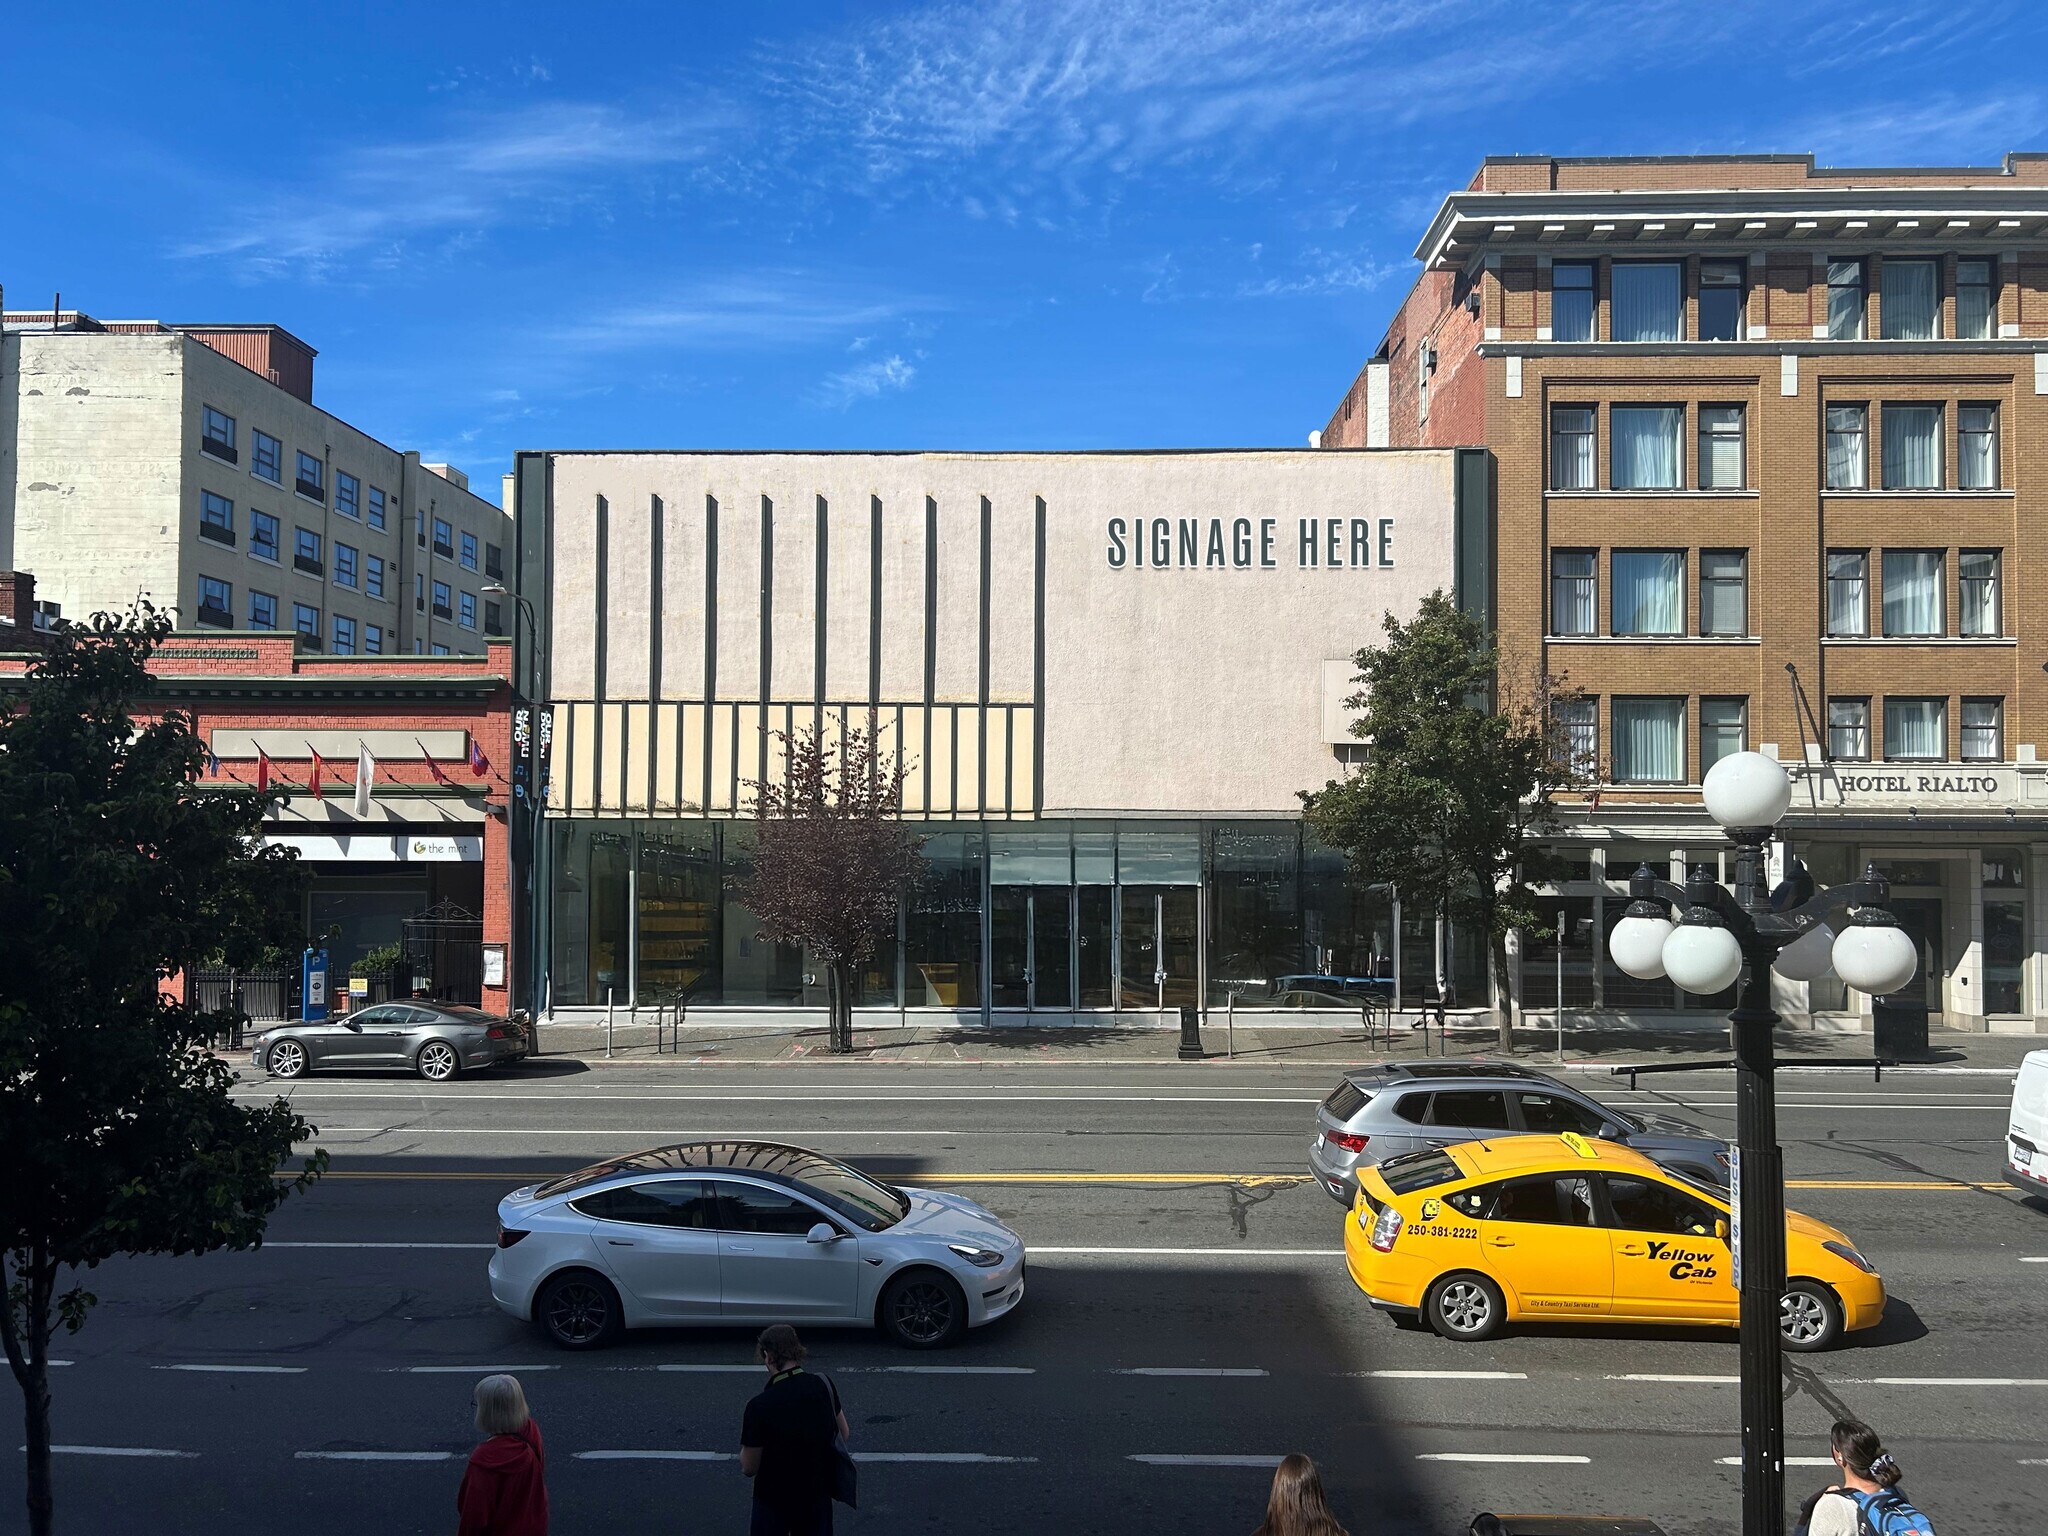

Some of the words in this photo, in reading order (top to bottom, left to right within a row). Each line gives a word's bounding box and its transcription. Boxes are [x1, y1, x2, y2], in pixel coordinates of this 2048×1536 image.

[1107, 517, 1277, 568] SIGNAGE
[1299, 517, 1395, 568] HERE
[514, 709, 524, 742] OUR
[1840, 776, 1911, 792] HOTEL
[1917, 776, 1998, 793] RIALTO
[428, 843, 444, 854] the
[448, 844, 468, 854] mint
[1731, 1151, 1740, 1197] BUS
[1407, 1224, 1478, 1240] 250-381-2222
[1647, 1241, 1715, 1263] Yellow
[1669, 1262, 1717, 1280] Cab
[1544, 1300, 1563, 1308] Country
